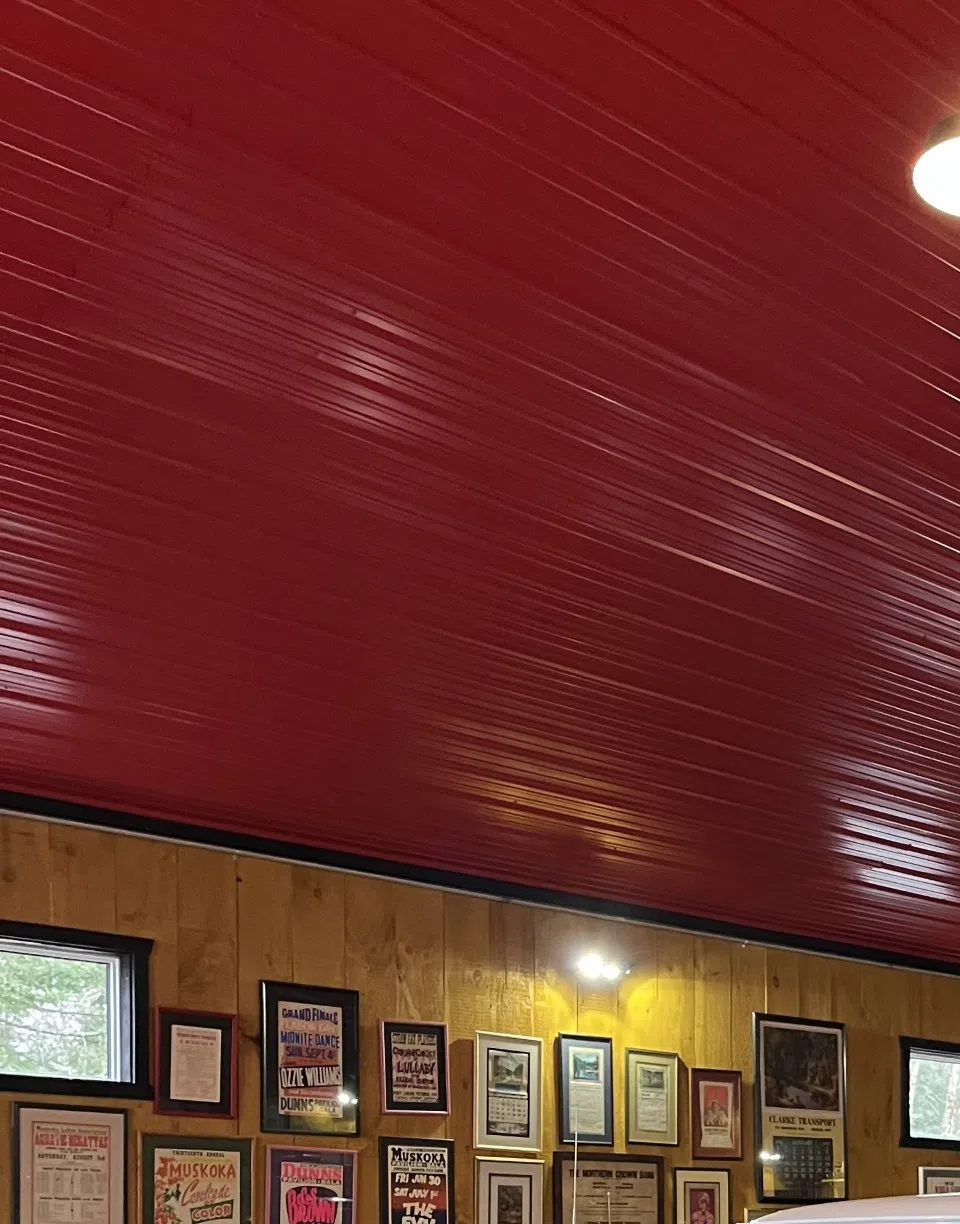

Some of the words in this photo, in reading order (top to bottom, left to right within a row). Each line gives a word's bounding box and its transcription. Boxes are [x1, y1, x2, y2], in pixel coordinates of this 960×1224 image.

[282, 1008, 311, 1021] GRAND
[312, 1008, 339, 1025] FINALE
[280, 1031, 312, 1046] MIDNITE
[315, 1034, 340, 1048] DANCE
[397, 1060, 436, 1075] LULLABY
[281, 1067, 304, 1088] OZZIE
[305, 1066, 340, 1087] WILLIAMS
[769, 1115, 796, 1125] CLARKE
[799, 1117, 836, 1127] TRANSPORT
[391, 1147, 446, 1164] MUSKOKA
[170, 1163, 236, 1179] MUSKOKA
[395, 1172, 409, 1184] FRI
[428, 1175, 441, 1186] 30
[394, 1187, 409, 1197] SAT
[409, 1188, 429, 1199] JULY
[192, 1204, 232, 1221] COLOR
[402, 1202, 437, 1219] THE
